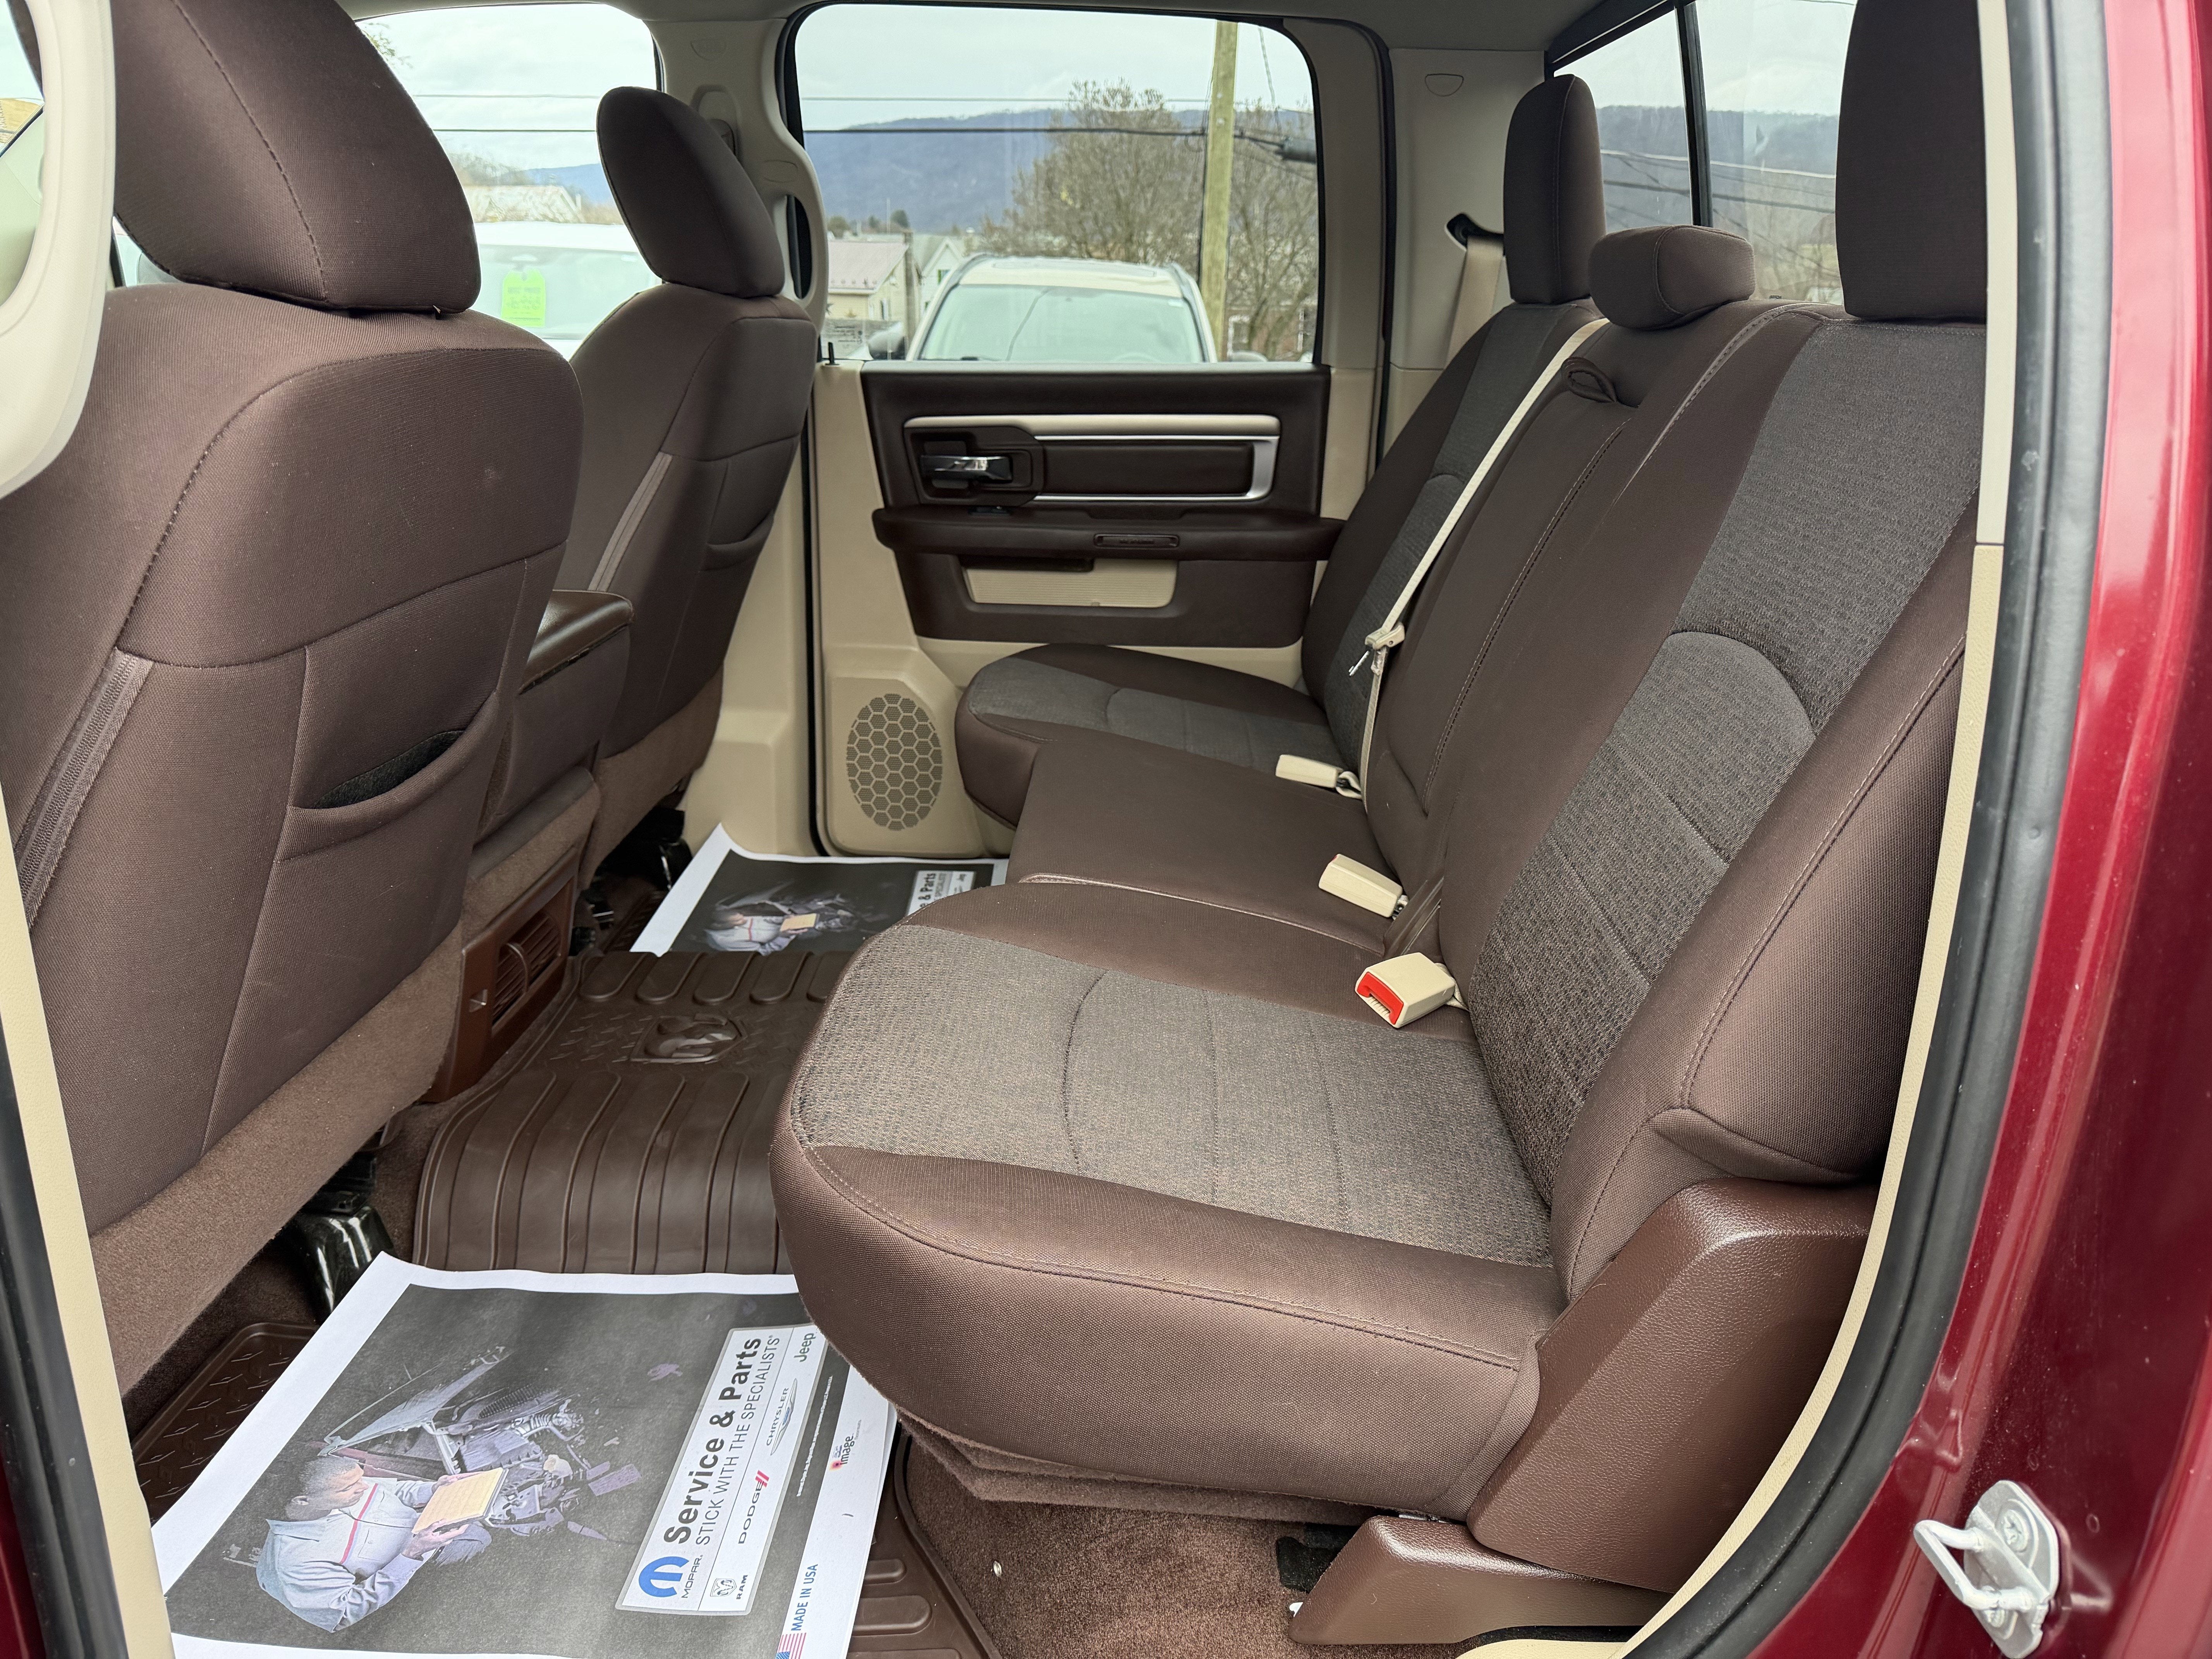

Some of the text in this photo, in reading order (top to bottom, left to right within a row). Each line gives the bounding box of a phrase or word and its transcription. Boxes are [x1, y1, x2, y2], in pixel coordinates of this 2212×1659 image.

[919, 873, 937, 892] Parts
[793, 1333, 816, 1362] Jeep
[664, 1338, 761, 1544] Service & Parts
[696, 1337, 780, 1545] STICK WITH THE SPECIALISTS
[766, 1388, 789, 1446] CHRYSLER
[835, 1435, 855, 1467] image
[738, 1480, 765, 1544] DODGE
[681, 1557, 702, 1599] MOPAR
[736, 1575, 748, 1600] RAM
[791, 1564, 818, 1631] MADE IN USA
